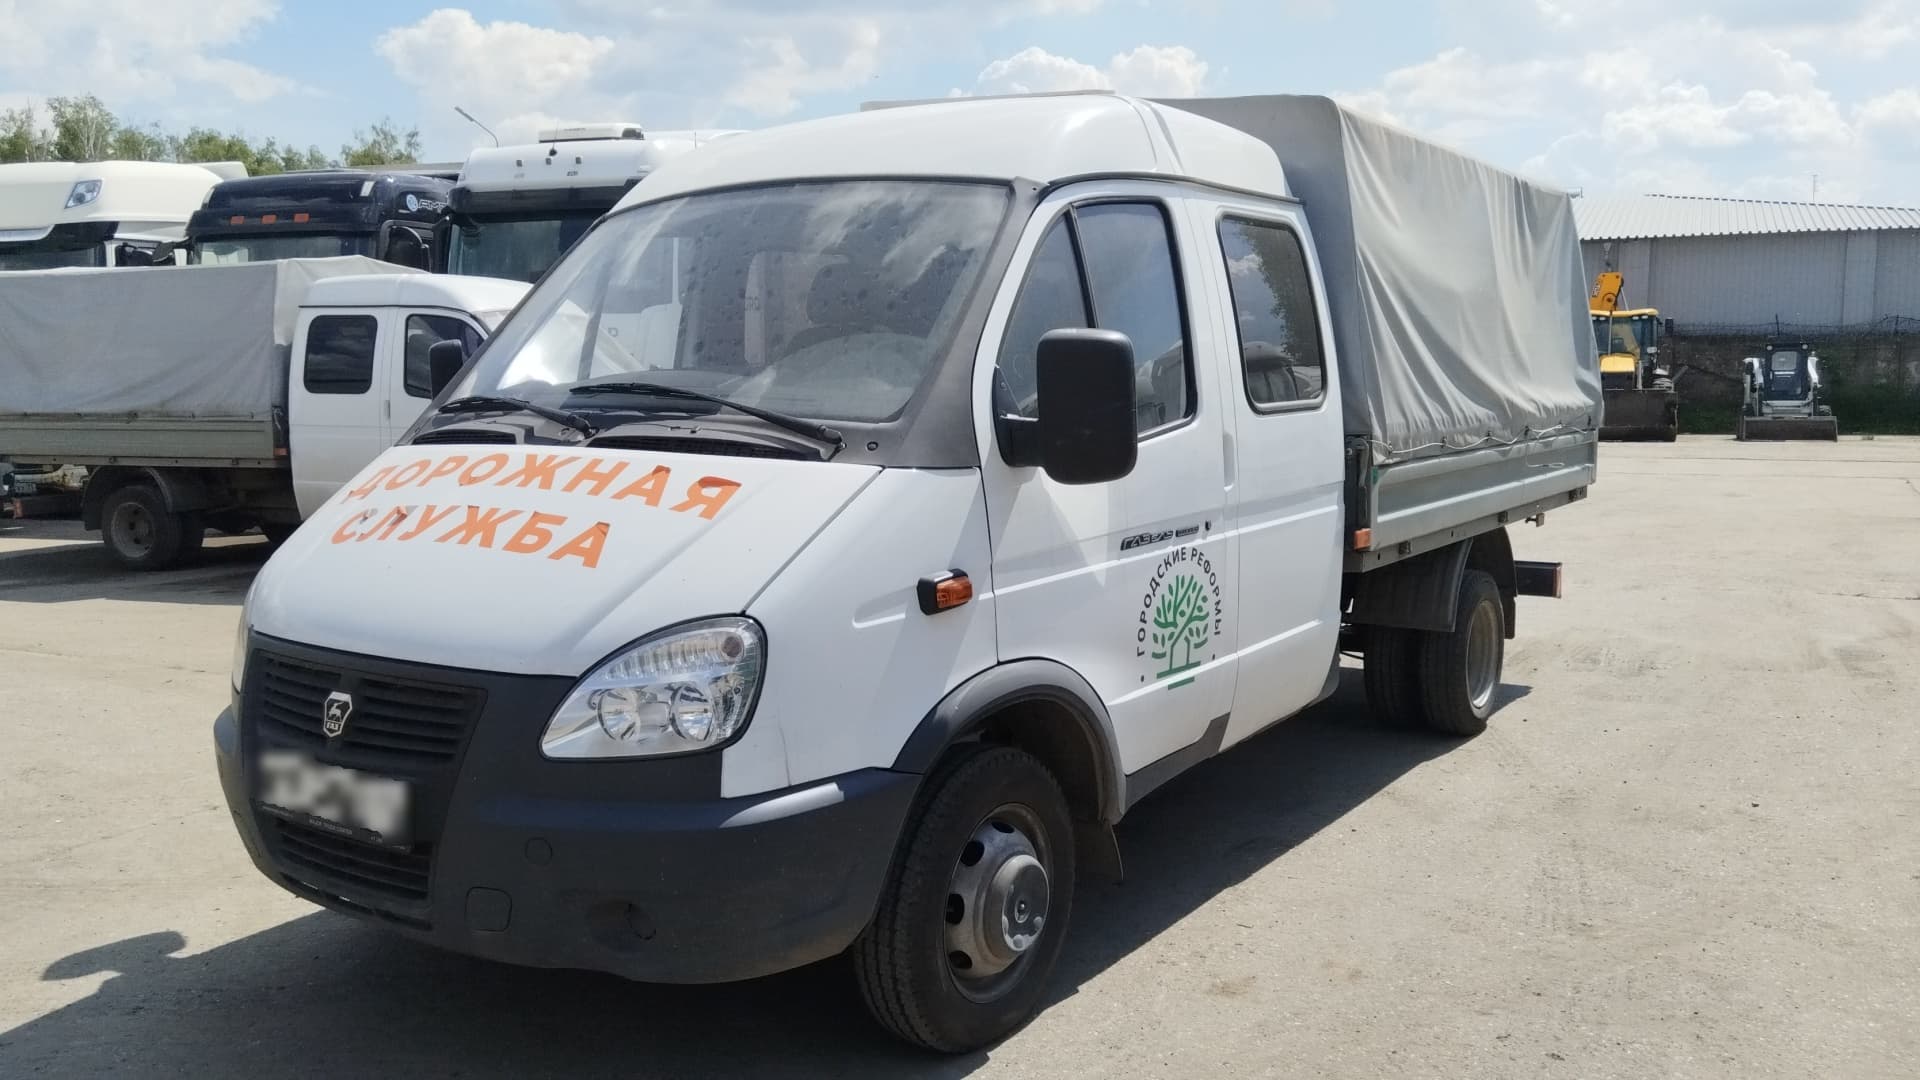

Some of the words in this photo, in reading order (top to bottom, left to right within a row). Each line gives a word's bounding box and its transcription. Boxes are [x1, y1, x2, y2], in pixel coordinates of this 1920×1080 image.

[342, 453, 742, 521] ДОРОЖНАЯ
[331, 504, 611, 569] СЛУЖБА
[1137, 547, 1187, 657] ГОРОДСКИЕ
[1190, 547, 1222, 636] РЕФОРМЫ
